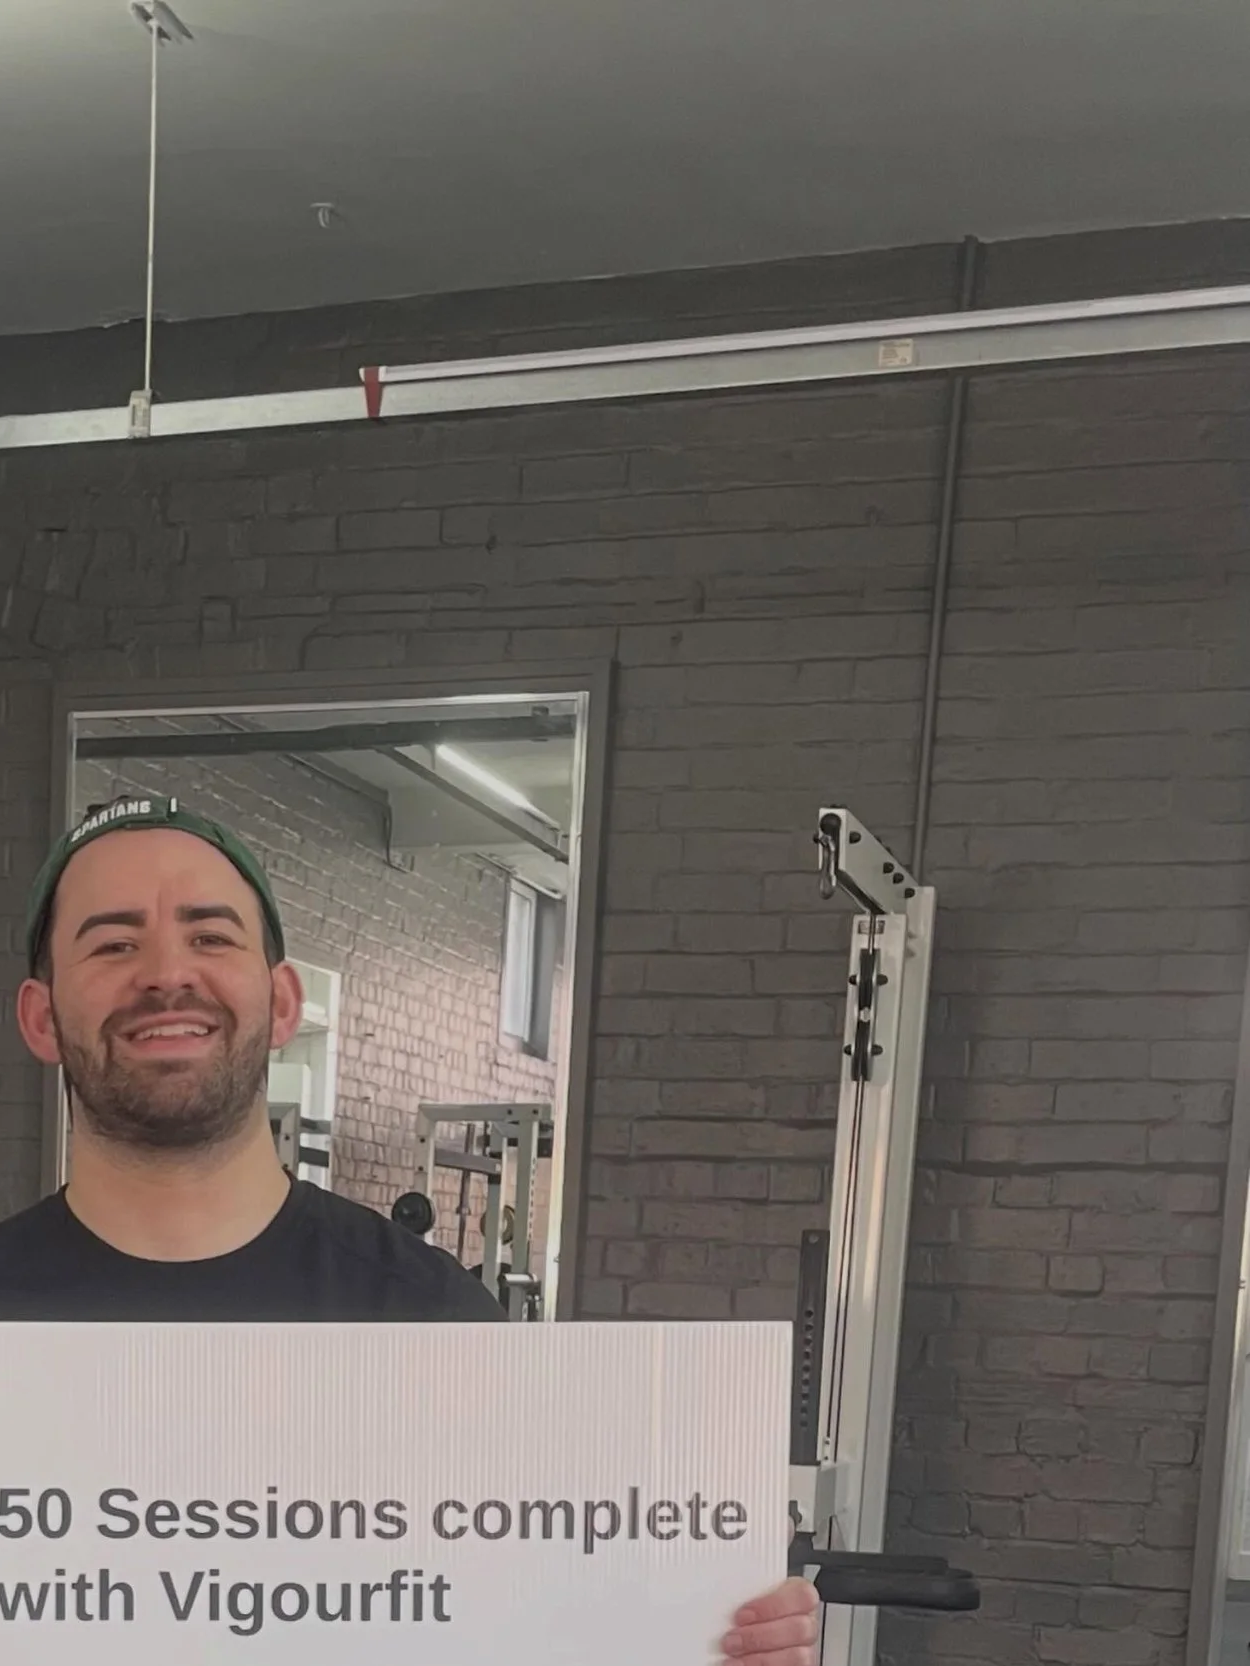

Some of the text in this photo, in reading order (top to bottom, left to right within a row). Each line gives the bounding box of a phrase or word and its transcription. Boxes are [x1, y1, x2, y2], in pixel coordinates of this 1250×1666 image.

[96, 1486, 409, 1541] Sessions
[432, 1486, 749, 1555] complete
[159, 1568, 452, 1637] Vigourfit
